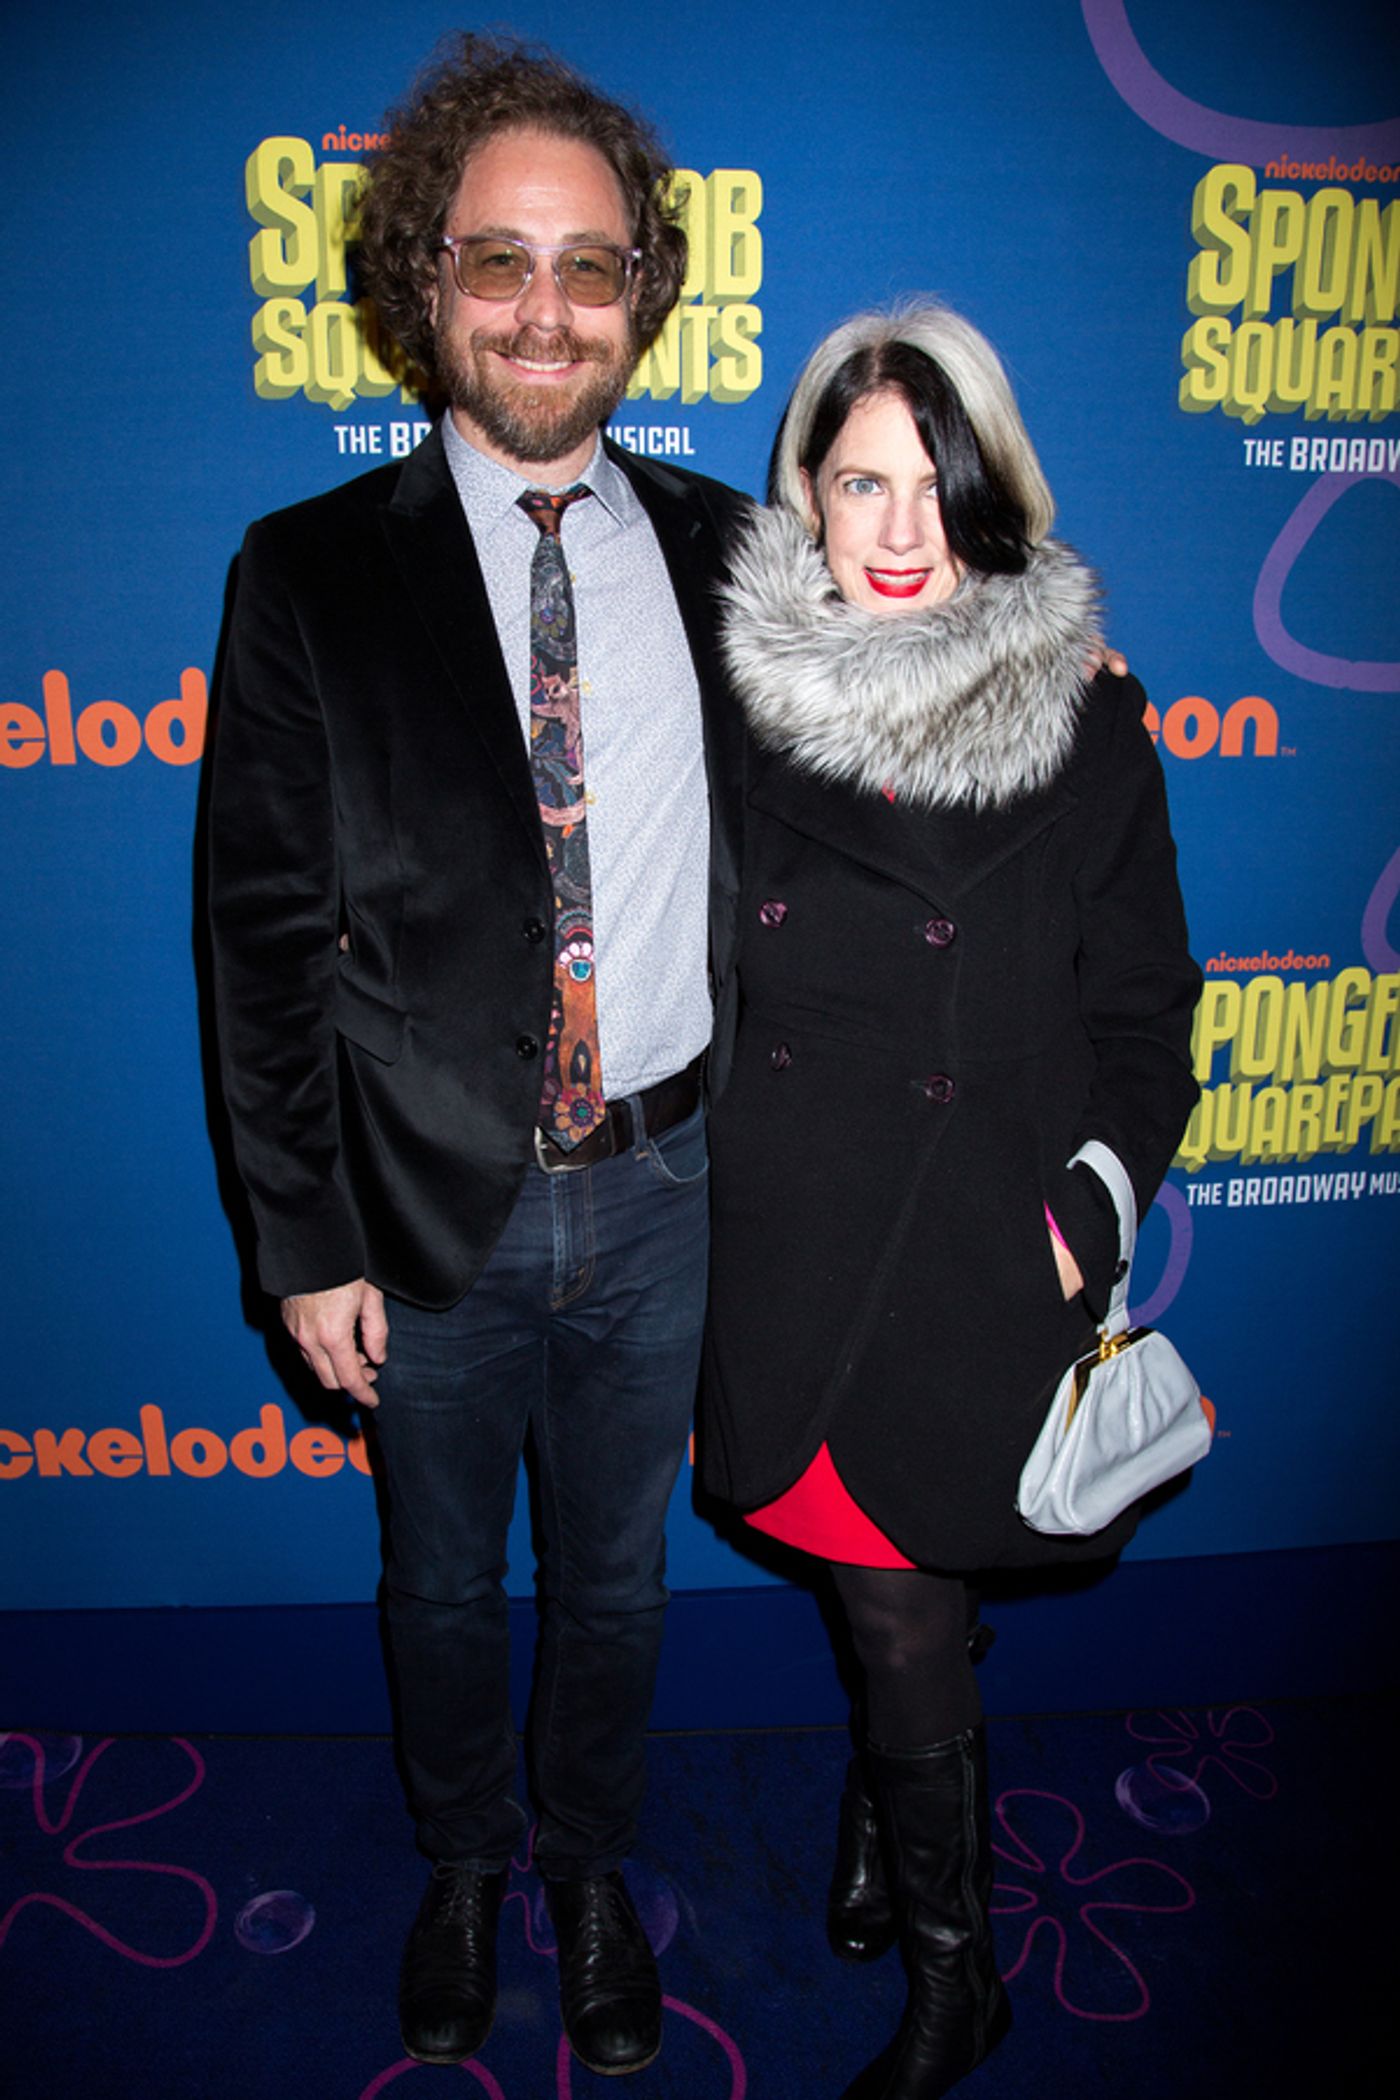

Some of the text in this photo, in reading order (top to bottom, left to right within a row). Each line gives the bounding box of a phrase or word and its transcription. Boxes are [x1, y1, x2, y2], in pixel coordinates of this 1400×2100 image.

[333, 425, 382, 454] THE
[1243, 439, 1284, 467] THE
[1141, 695, 1279, 760] on
[1206, 950, 1330, 973] nickelodeon
[1187, 1183, 1222, 1206] THE
[1228, 1171, 1366, 1207] BROADWAY
